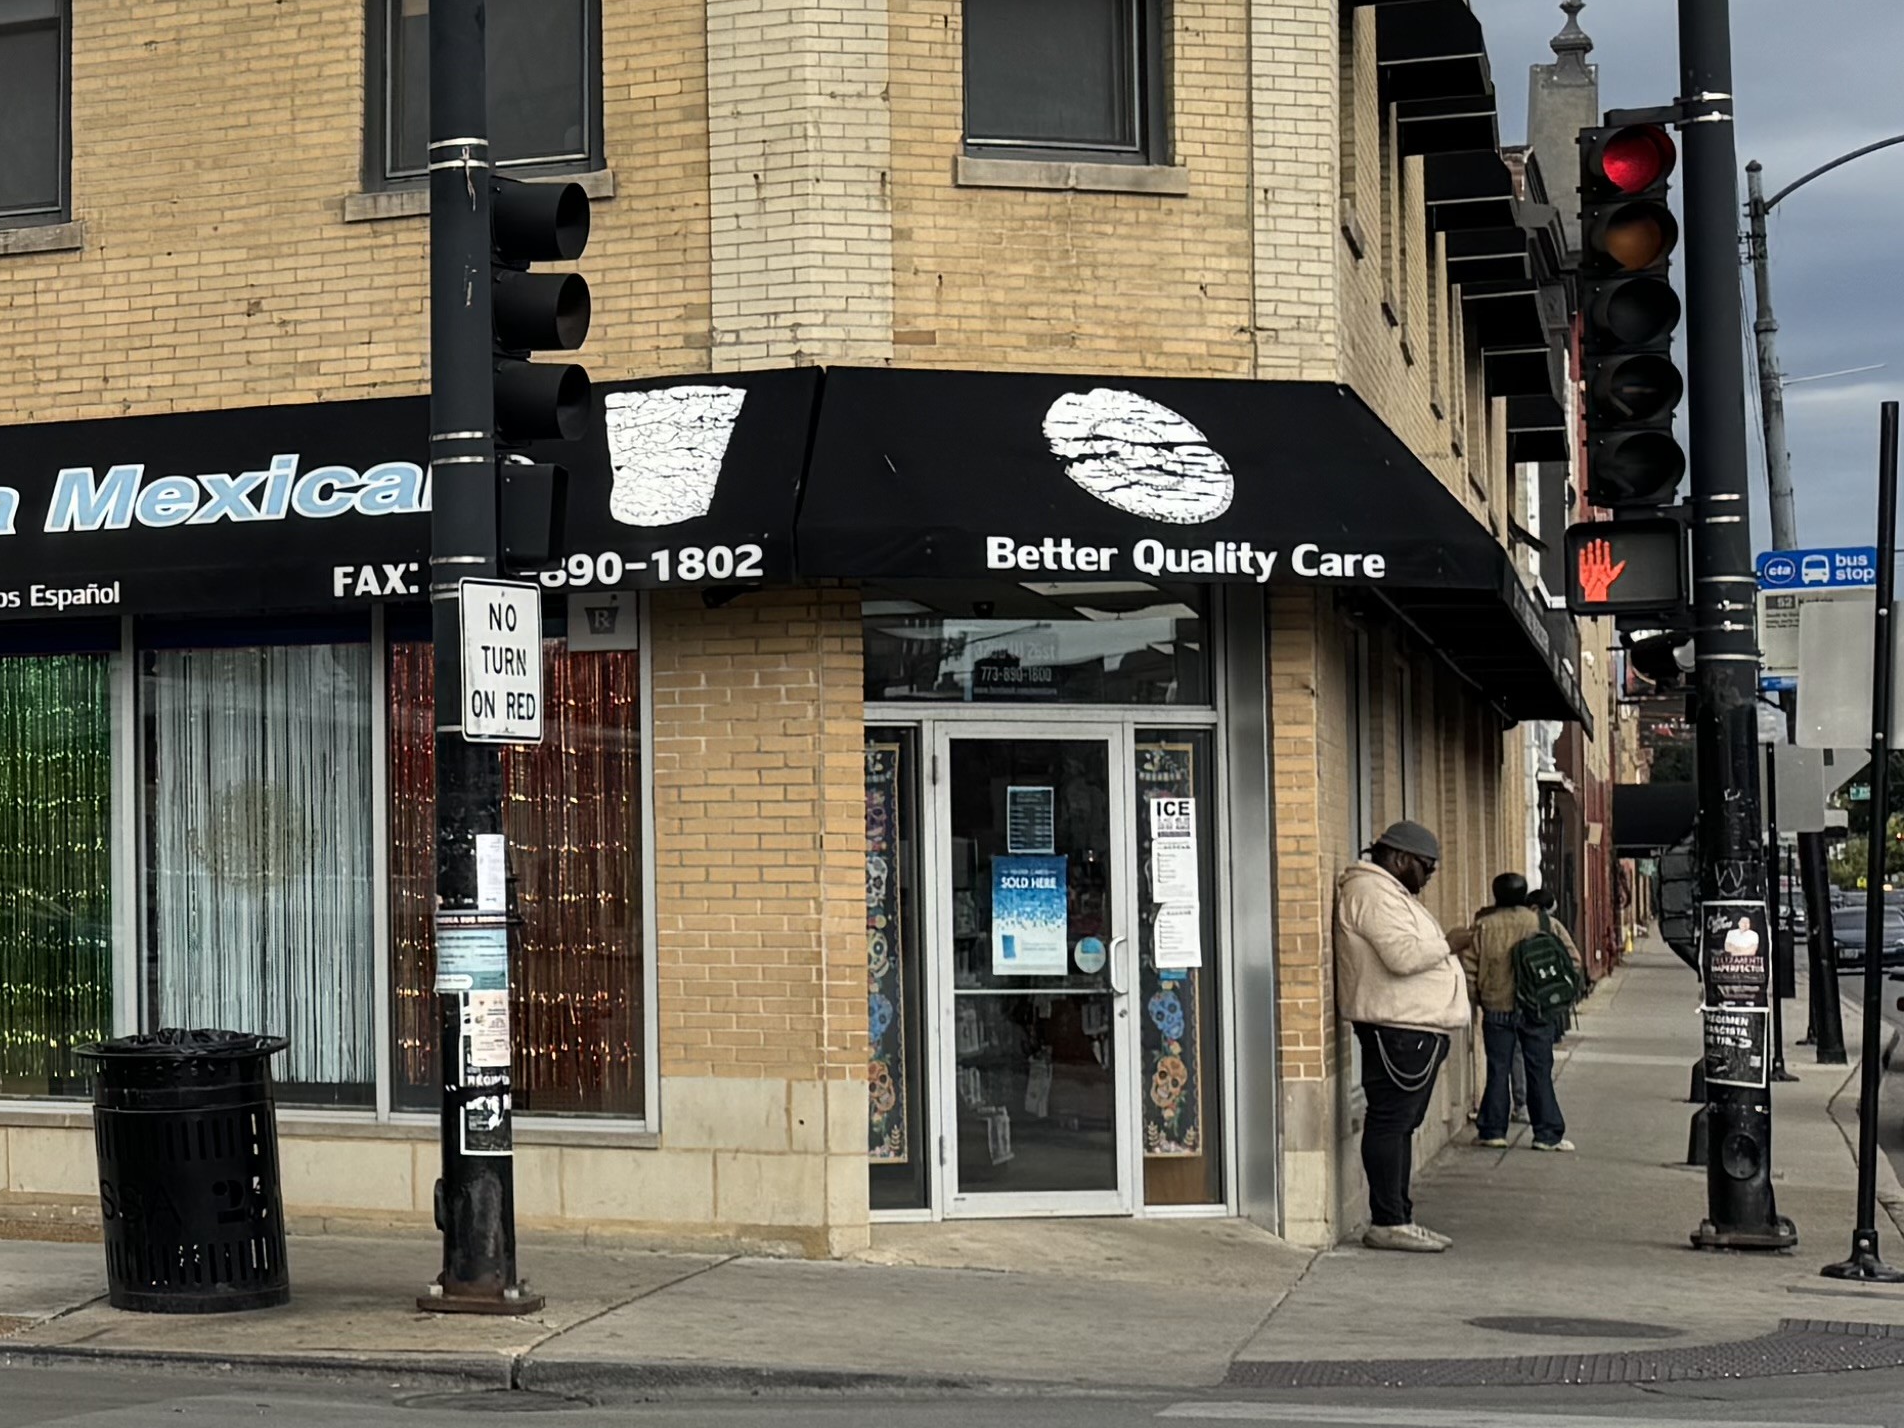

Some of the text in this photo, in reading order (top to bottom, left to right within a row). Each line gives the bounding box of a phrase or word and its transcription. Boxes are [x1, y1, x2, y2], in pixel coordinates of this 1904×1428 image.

[43, 453, 432, 533] Mexica
[986, 536, 1386, 582] Better Quality Care
[1768, 565, 1792, 576] cta
[1835, 553, 1868, 567] bus
[333, 562, 420, 598] FAX:
[1835, 567, 1876, 583] stop
[30, 579, 121, 611] Español
[489, 603, 517, 632] NO
[481, 646, 527, 677] TURN
[471, 690, 536, 721] ON RED
[1156, 801, 1190, 817] ICE
[1001, 876, 1029, 889] SOLD
